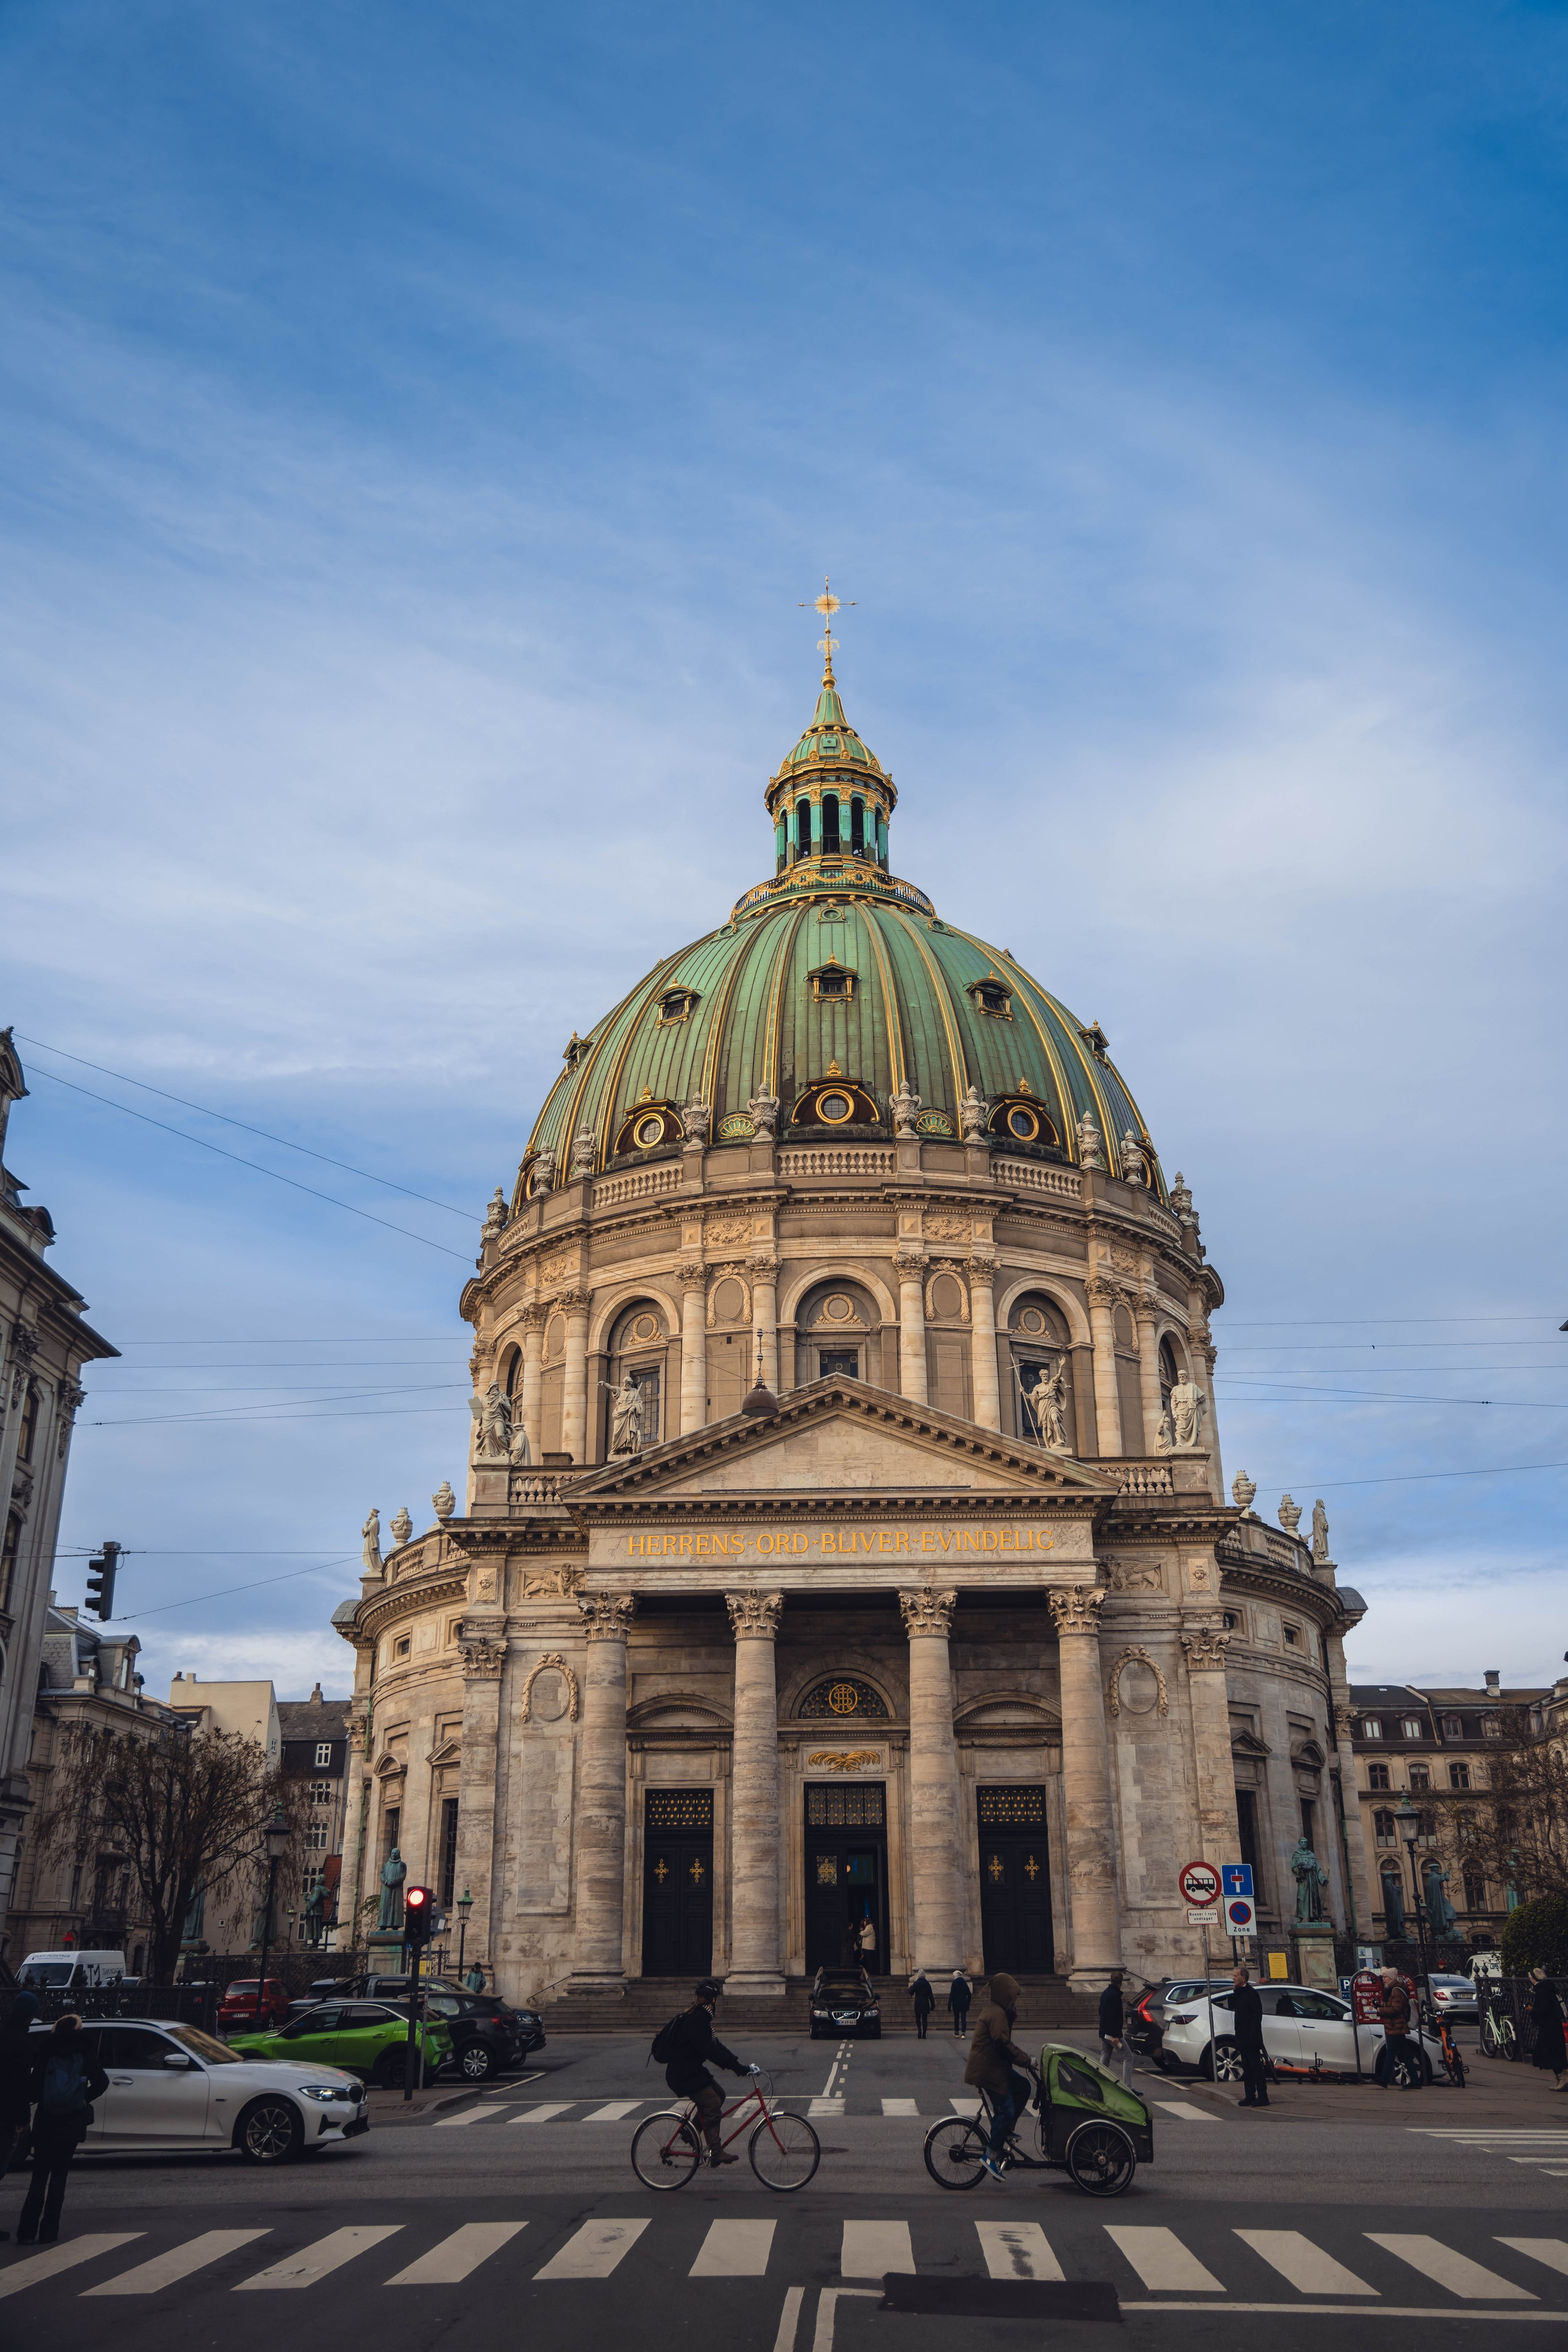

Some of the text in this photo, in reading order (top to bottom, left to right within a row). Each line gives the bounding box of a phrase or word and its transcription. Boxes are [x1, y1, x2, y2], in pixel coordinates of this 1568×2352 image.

[628, 1529, 1055, 1556] HERRENS ORD BLIVER EVINDELIG
[1343, 1980, 1350, 1989] P
